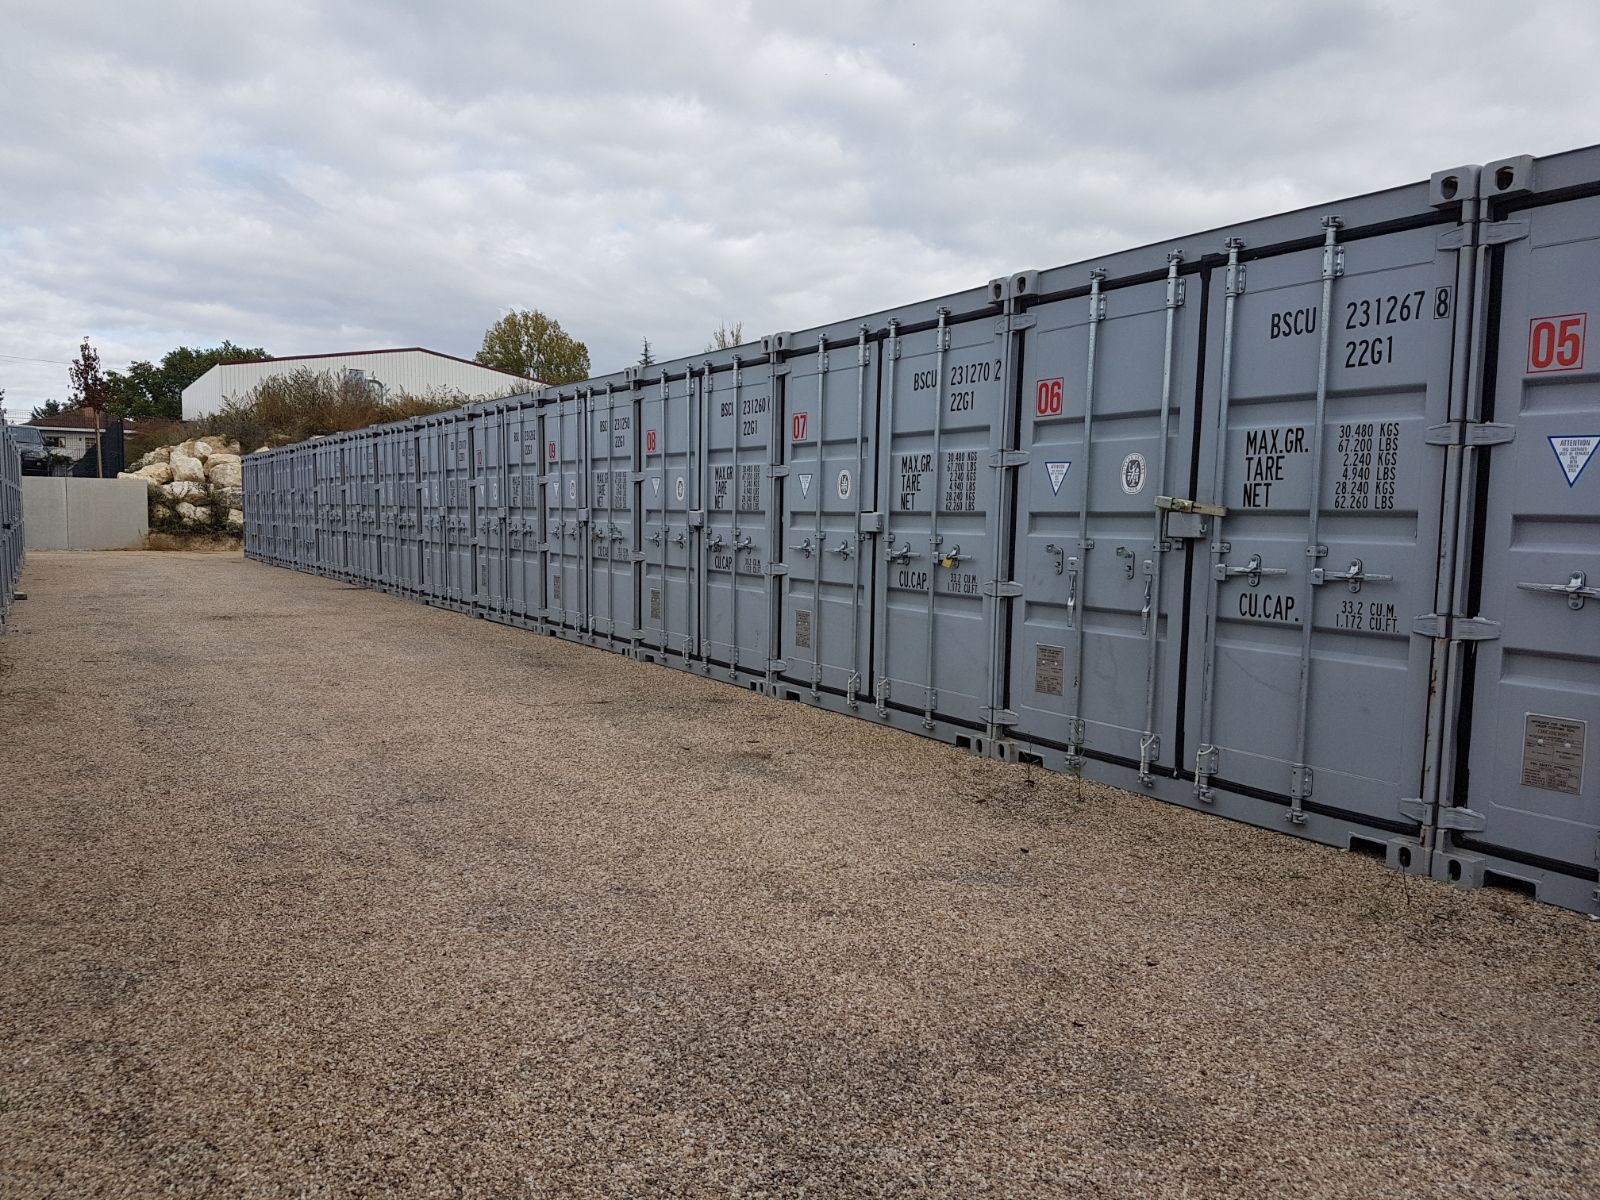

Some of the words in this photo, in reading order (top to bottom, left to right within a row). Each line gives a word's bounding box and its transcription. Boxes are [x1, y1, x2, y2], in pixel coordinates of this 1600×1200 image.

[1270, 307, 1317, 339] BSCU
[1345, 291, 1426, 329] 231267
[1436, 288, 1449, 317] 8
[1345, 336, 1393, 368] 22G1
[1531, 318, 1581, 369] 05
[913, 369, 937, 391] BSCU
[950, 362, 990, 386] 231270
[743, 398, 766, 415] 231260
[950, 391, 974, 412] 22G1
[1037, 381, 1061, 414] 06
[743, 420, 758, 435] 22G1
[793, 414, 807, 439] 07
[646, 431, 656, 451] 08
[1246, 427, 1309, 455] MAX.GR.
[1338, 424, 1374, 439] 30.480
[1380, 423, 1400, 437] KGS
[1338, 438, 1372, 453] 67.200
[1378, 437, 1399, 452] LBS
[1560, 439, 1591, 447] ATTENTION
[548, 442, 556, 458] 09
[902, 454, 934, 473] MAX.GR.
[1245, 456, 1286, 481] TARE
[1343, 453, 1372, 467] 2.240
[1377, 452, 1397, 466] KGS
[902, 474, 922, 492] TARE
[1342, 467, 1371, 481] 4.940
[1376, 467, 1396, 480] LBS
[900, 493, 915, 510] NET
[1243, 483, 1272, 507] NET
[1335, 481, 1369, 495] 28.240
[1375, 481, 1395, 495] KGS
[1334, 495, 1368, 509] 62.260
[1374, 495, 1394, 509] LBS
[899, 570, 930, 590] CU.CAP.
[1239, 592, 1299, 622] CU.CAP.
[1341, 601, 1363, 616] 33.2
[1369, 602, 1397, 618] CU.M.
[1336, 614, 1362, 629] 1.172
[1369, 616, 1400, 633] CU.FT.
